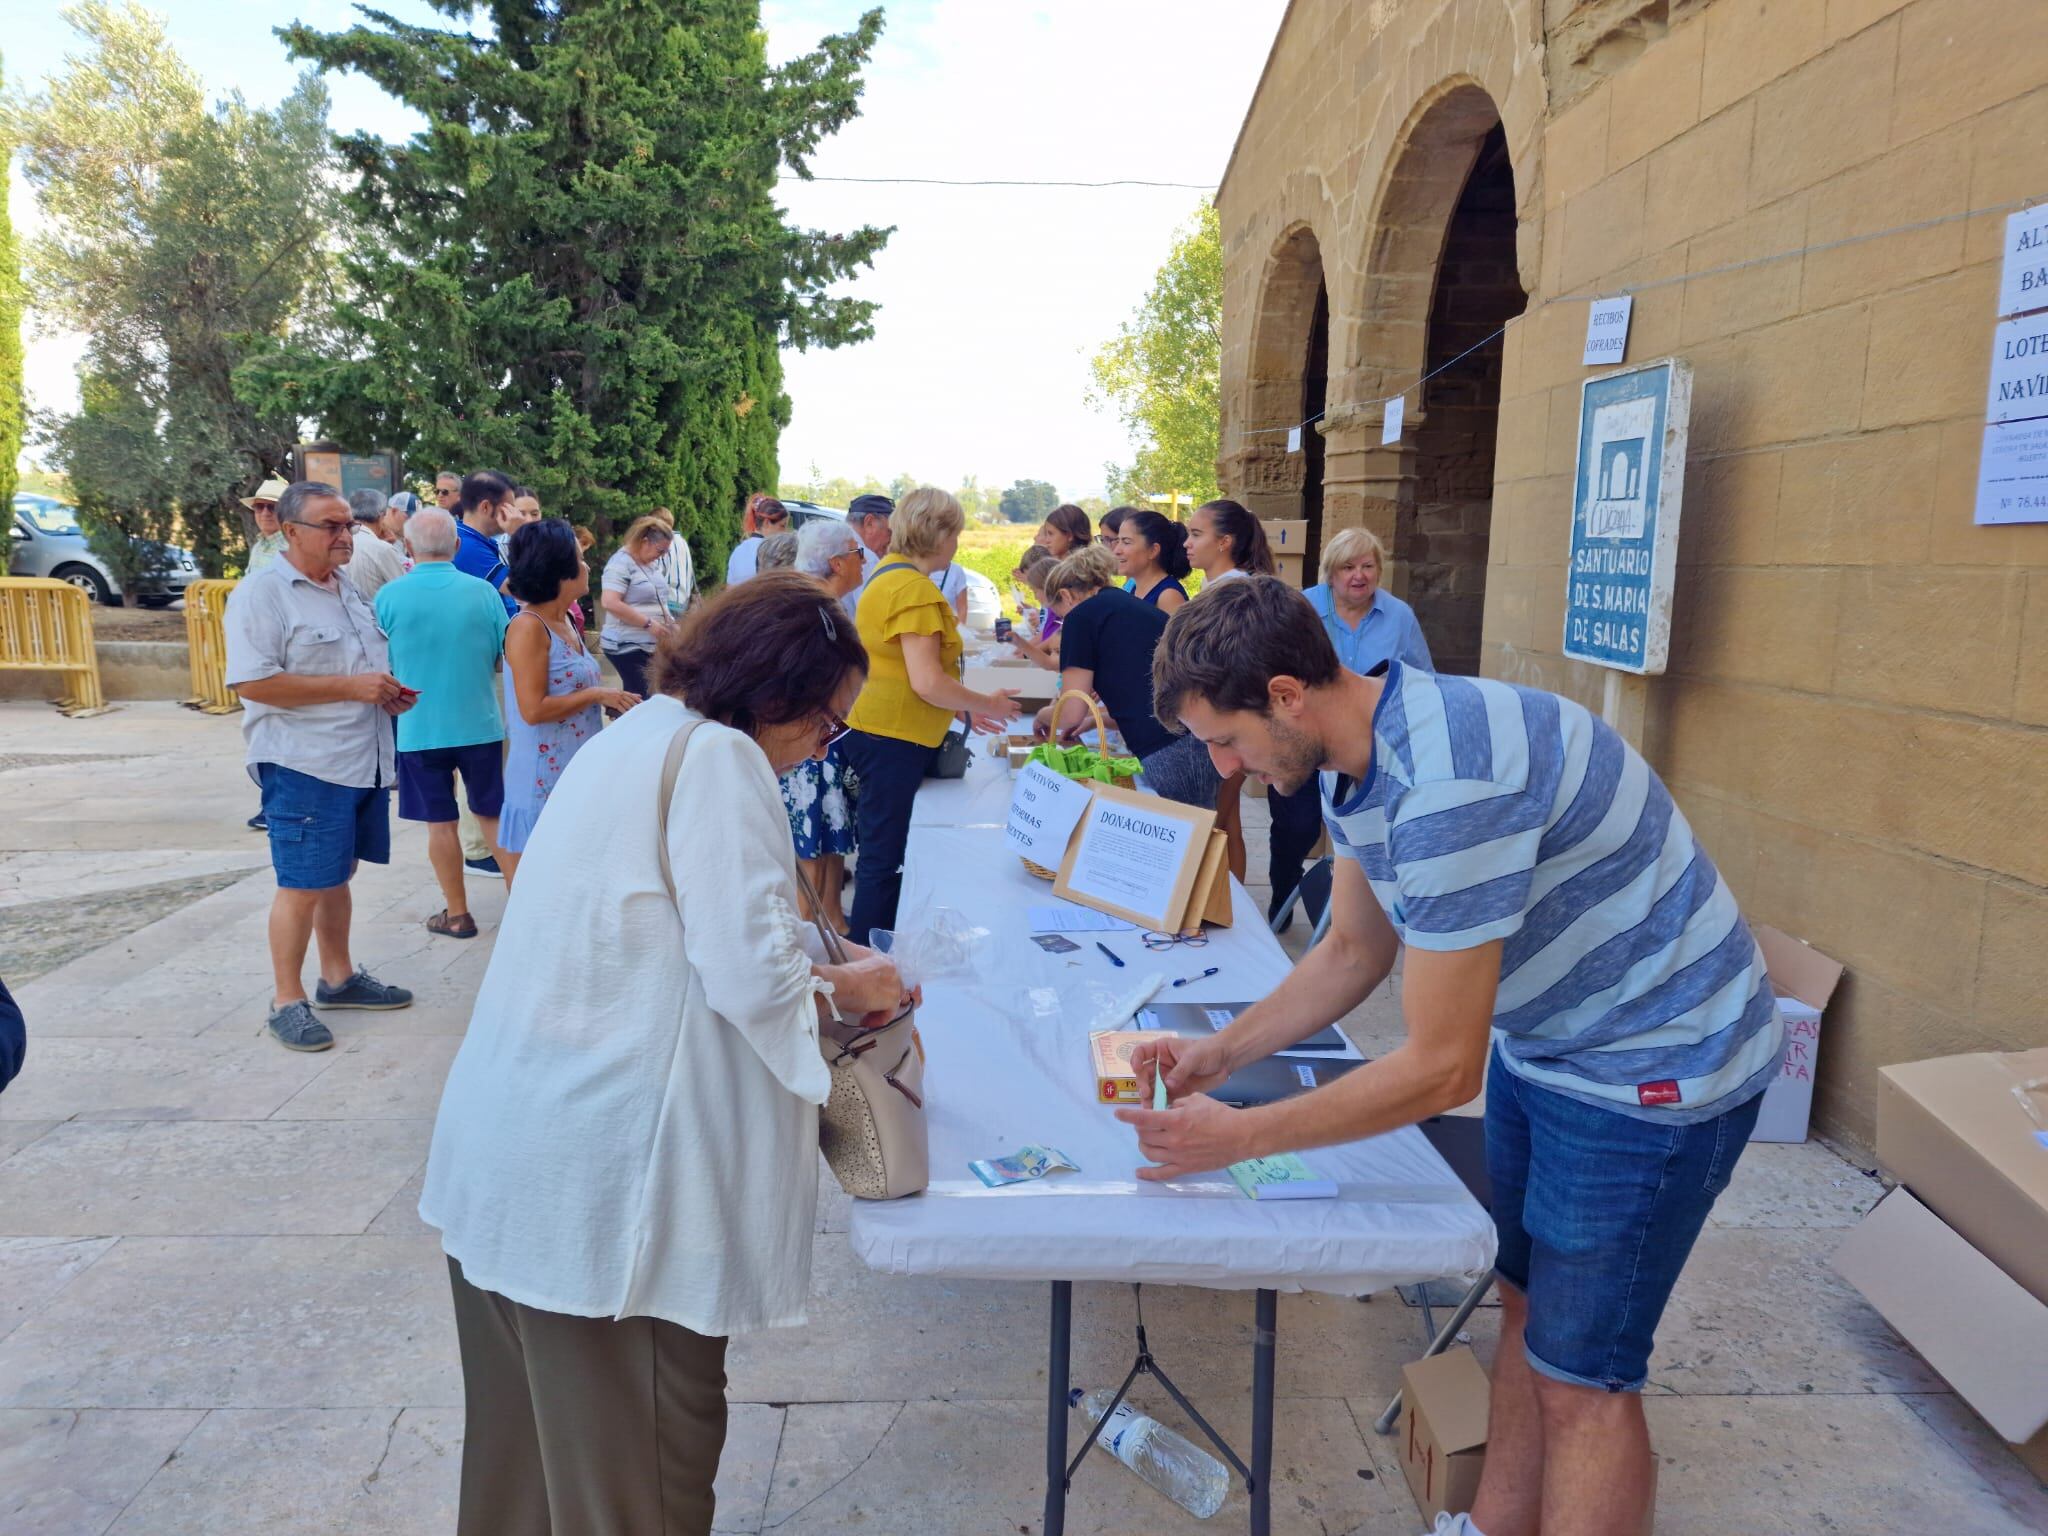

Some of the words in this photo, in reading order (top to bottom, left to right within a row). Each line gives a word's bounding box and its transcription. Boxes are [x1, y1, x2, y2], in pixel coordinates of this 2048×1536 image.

[1593, 311, 1624, 326] RECIBOS
[1587, 338, 1624, 352] COFRADES
[1998, 373, 2048, 401] NAVI
[1577, 548, 1649, 575] SANTUARIO
[1574, 582, 1589, 608] DE
[1573, 618, 1588, 643] DE
[1593, 622, 1640, 653] SALAS
[1100, 811, 1177, 843] DONACIONES
